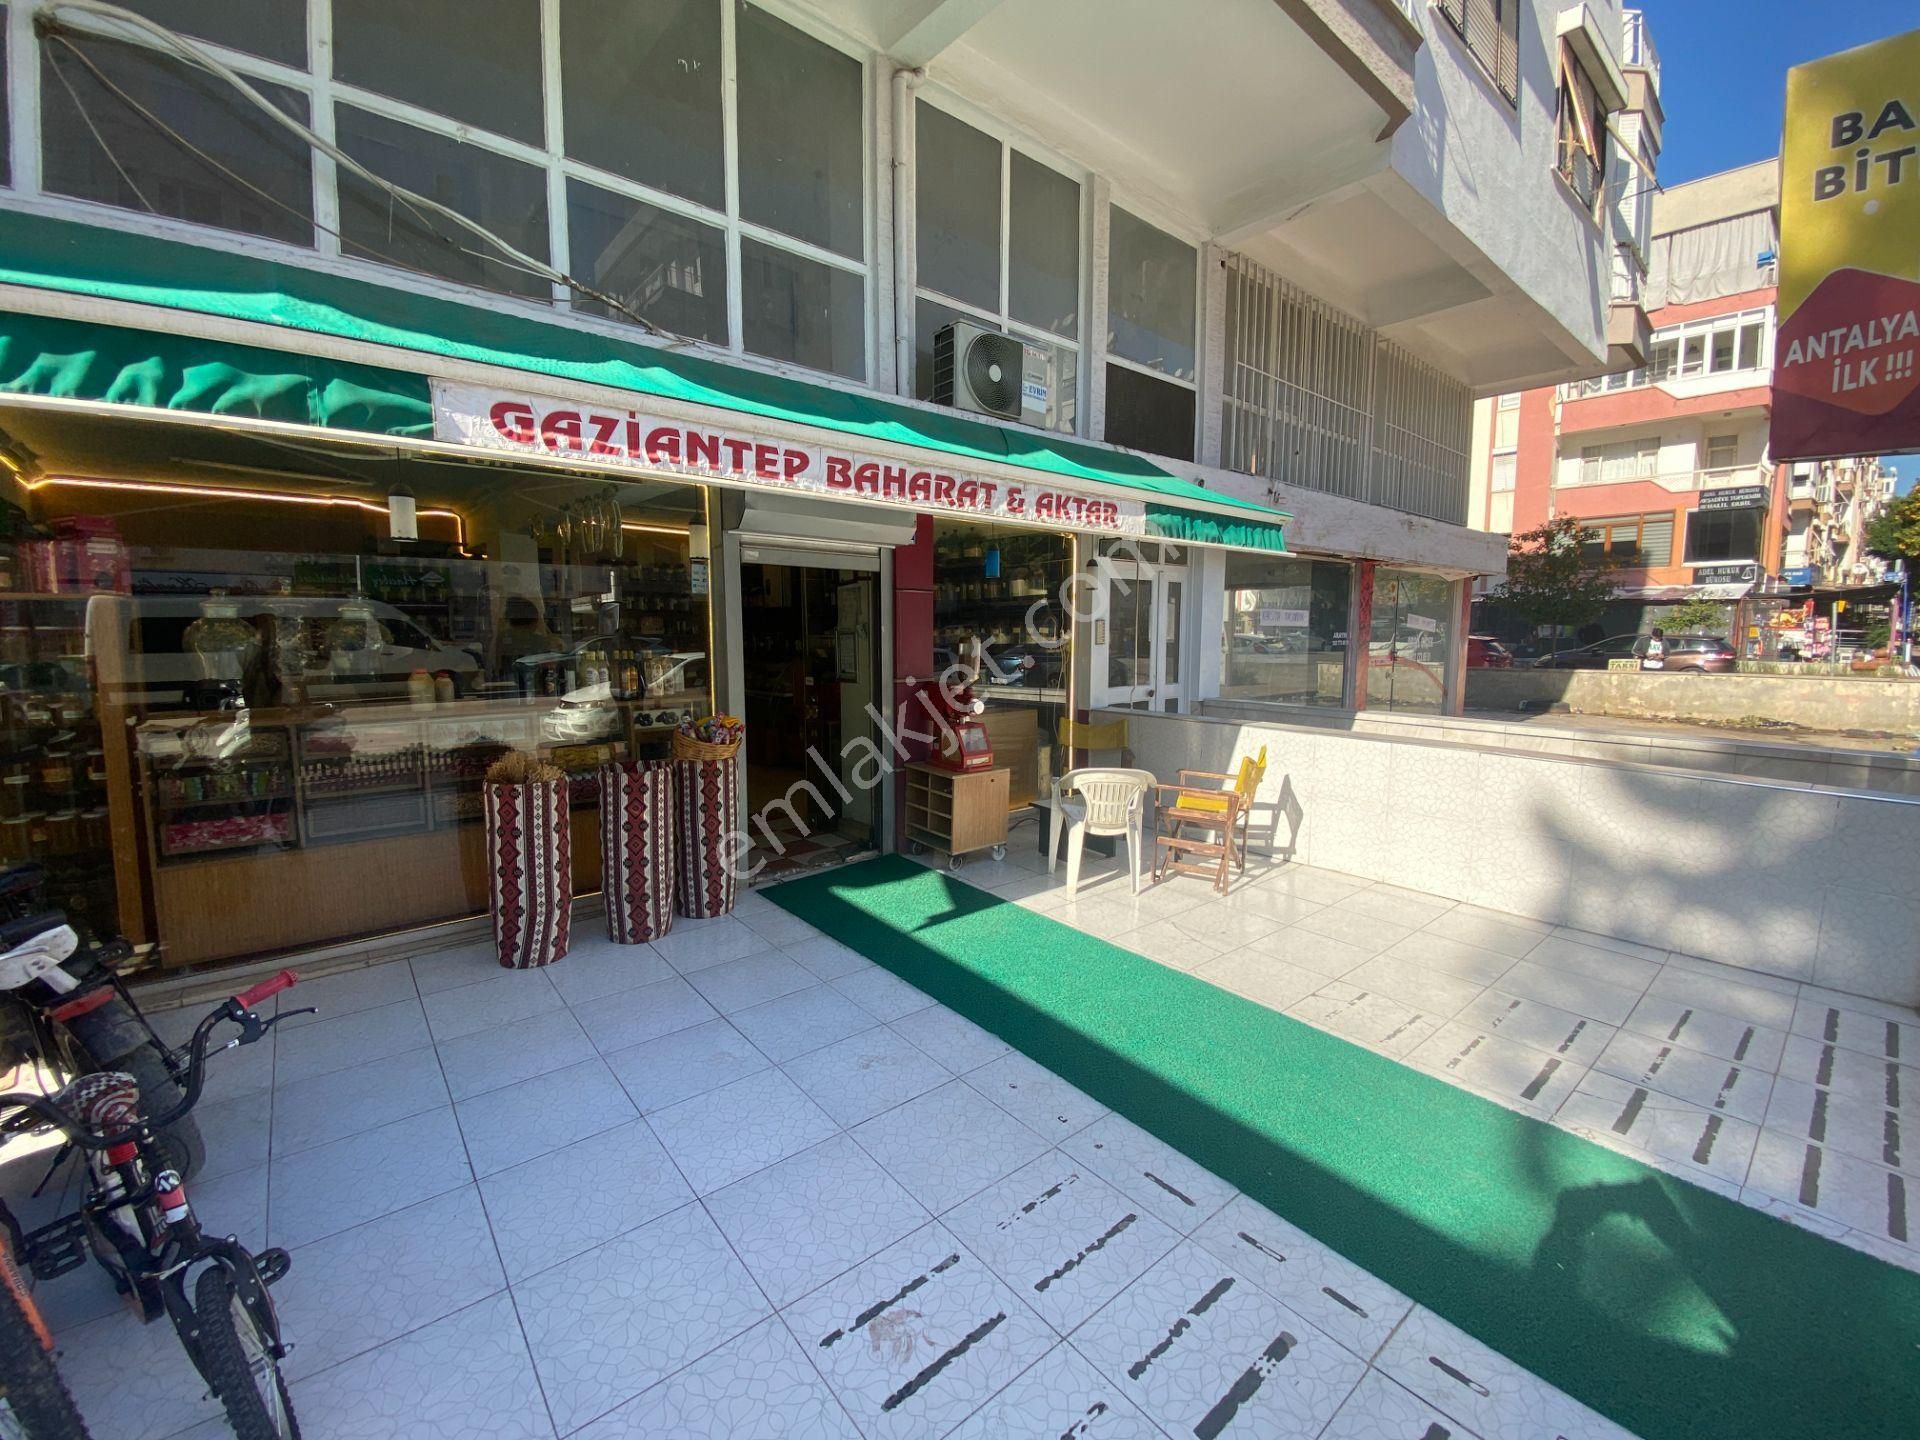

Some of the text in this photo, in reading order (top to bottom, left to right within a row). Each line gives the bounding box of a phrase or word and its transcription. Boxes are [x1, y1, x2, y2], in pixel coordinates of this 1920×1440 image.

[1784, 310, 1920, 367] ANTALYA
[1832, 356, 1879, 394] İLK
[489, 401, 1118, 528] GAZİANTEP BAHARAT & AKTAR
